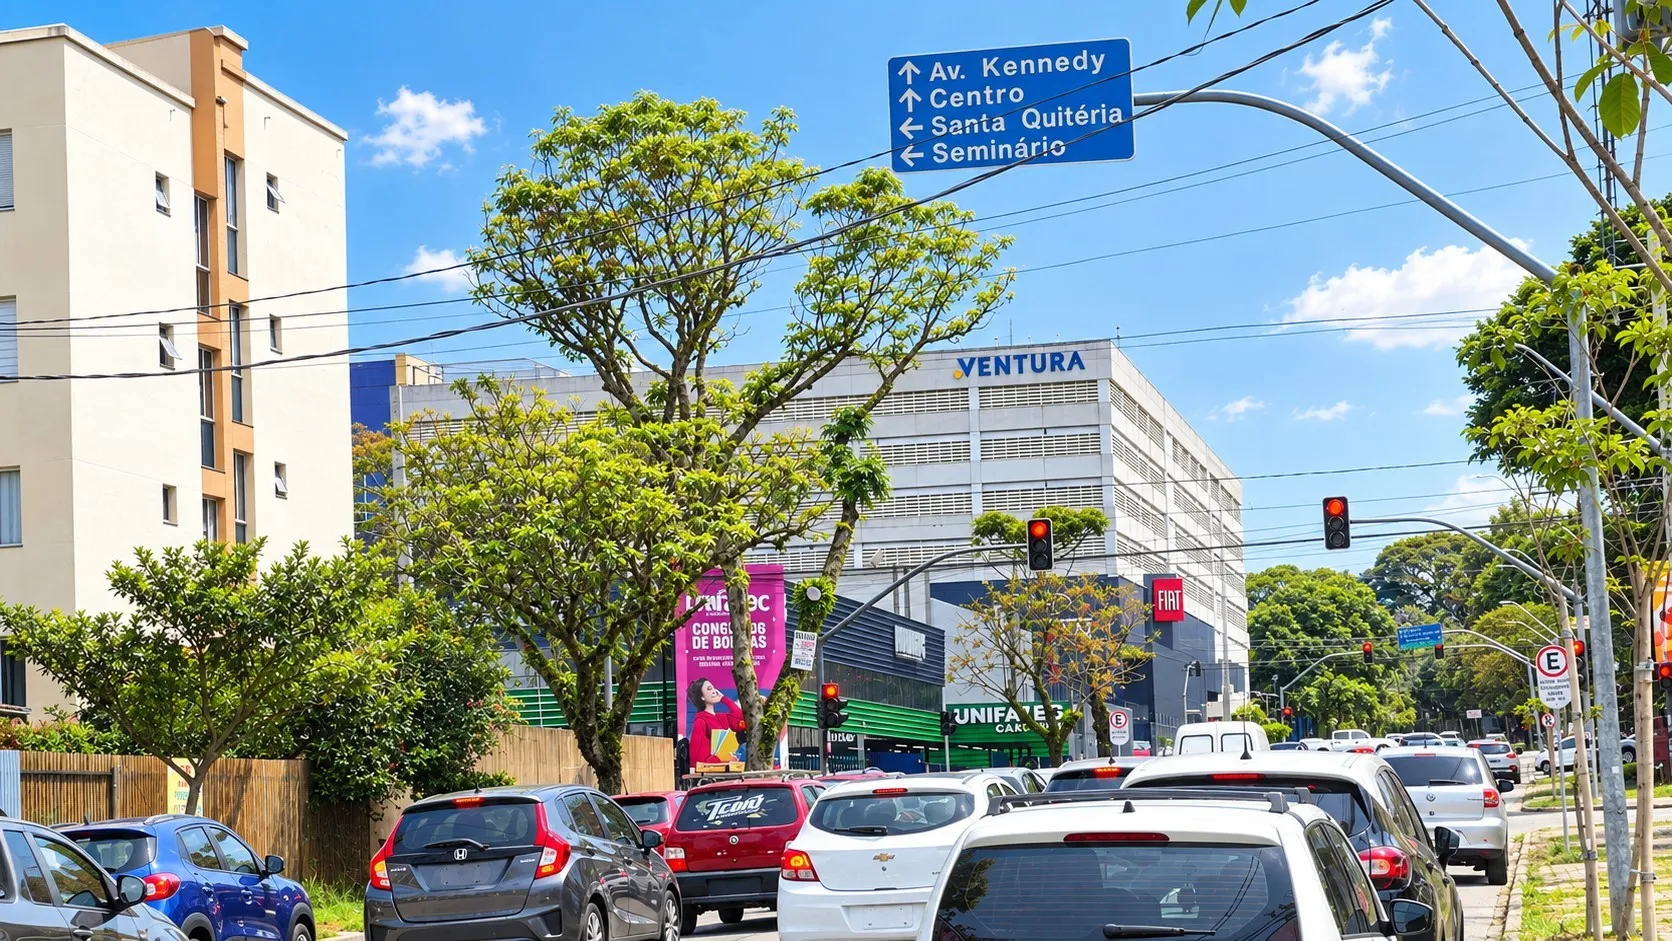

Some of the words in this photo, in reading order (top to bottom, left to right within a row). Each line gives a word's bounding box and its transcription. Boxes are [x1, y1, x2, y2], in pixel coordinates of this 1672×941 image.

[929, 61, 966, 82] Av.
[983, 49, 1106, 77] Kennedy
[929, 85, 1024, 109] Centro
[931, 113, 1006, 137] Santa
[1021, 103, 1123, 130] Quitéria
[932, 136, 1066, 163] Seminário
[957, 351, 1085, 377] VENTURA
[1158, 590, 1182, 611] FIAT
[692, 636, 709, 649] DE
[1546, 652, 1560, 670] E
[1115, 715, 1122, 725] E
